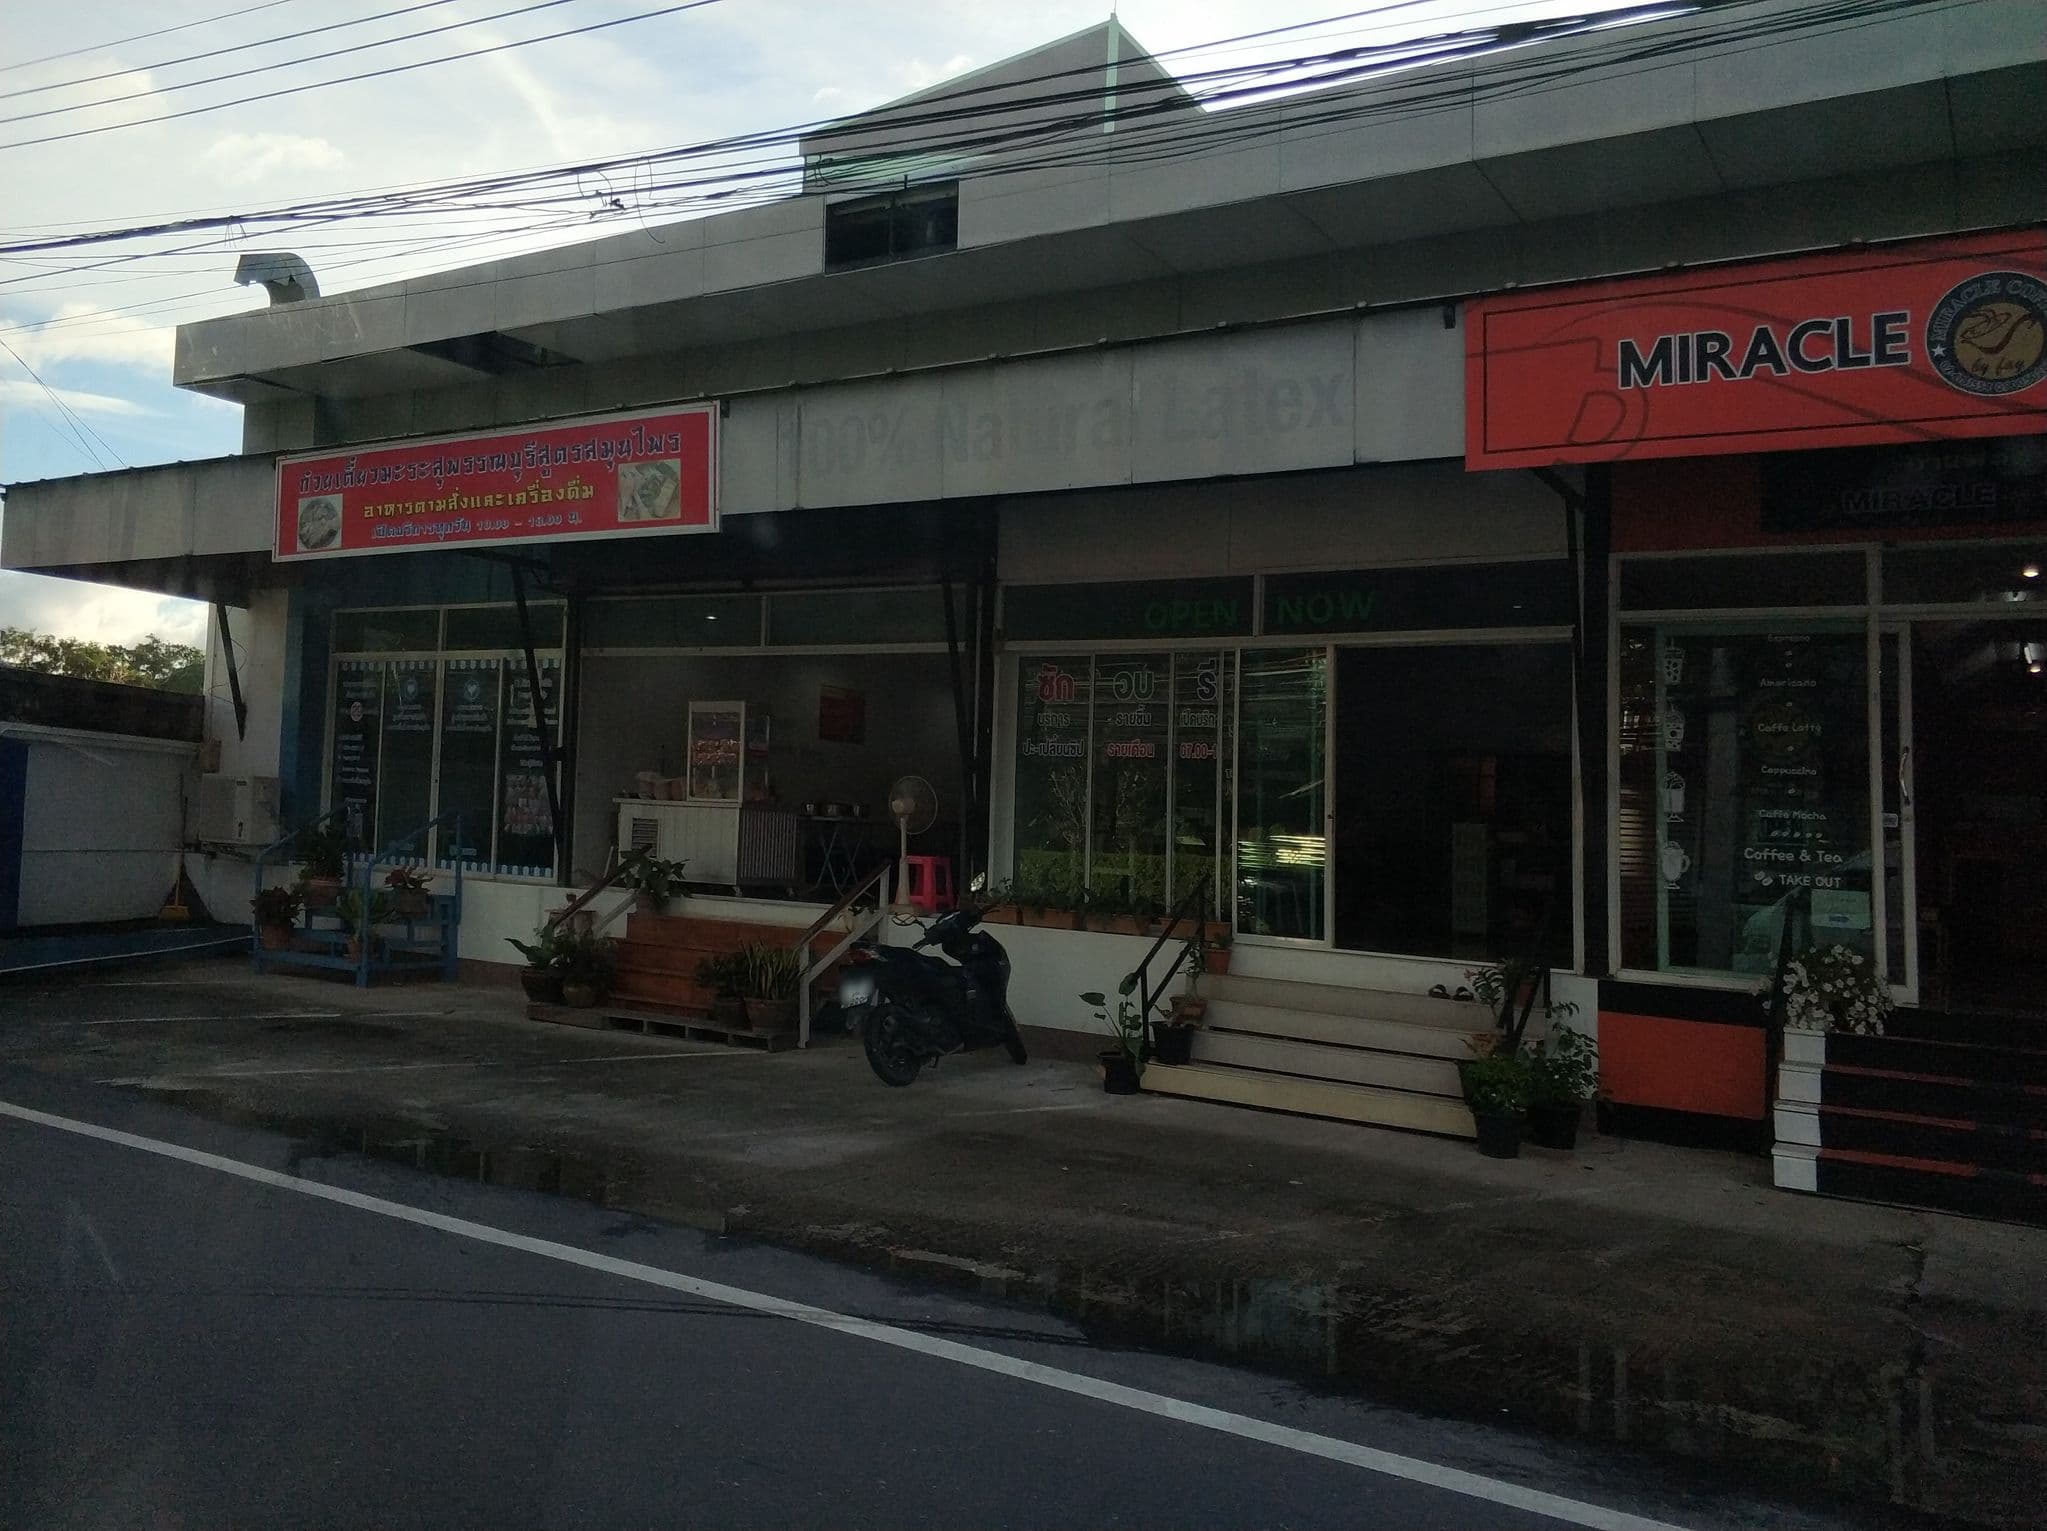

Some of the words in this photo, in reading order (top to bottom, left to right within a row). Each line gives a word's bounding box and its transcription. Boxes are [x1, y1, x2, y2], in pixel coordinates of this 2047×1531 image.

[1618, 311, 1911, 391] MIRACLE
[1160, 367, 1345, 445] Latex
[362, 475, 595, 519] อาหารตามสั่งและเครื่องดื่ม
[1840, 480, 1997, 514] MIRACLE
[1144, 597, 1241, 631] OPEN
[1277, 590, 1377, 625] NOW
[1037, 662, 1075, 703] ซัก
[1112, 670, 1155, 701] อบ
[1759, 677, 1817, 689] Americano
[1760, 765, 1817, 777] Cappuccino
[1792, 810, 1828, 821] Mocha
[1743, 847, 1795, 862] Coffee
[1798, 849, 1812, 863] &
[1815, 850, 1844, 864] Tea
[1778, 874, 1811, 887] TAKE
[1815, 875, 1842, 889] OUT
